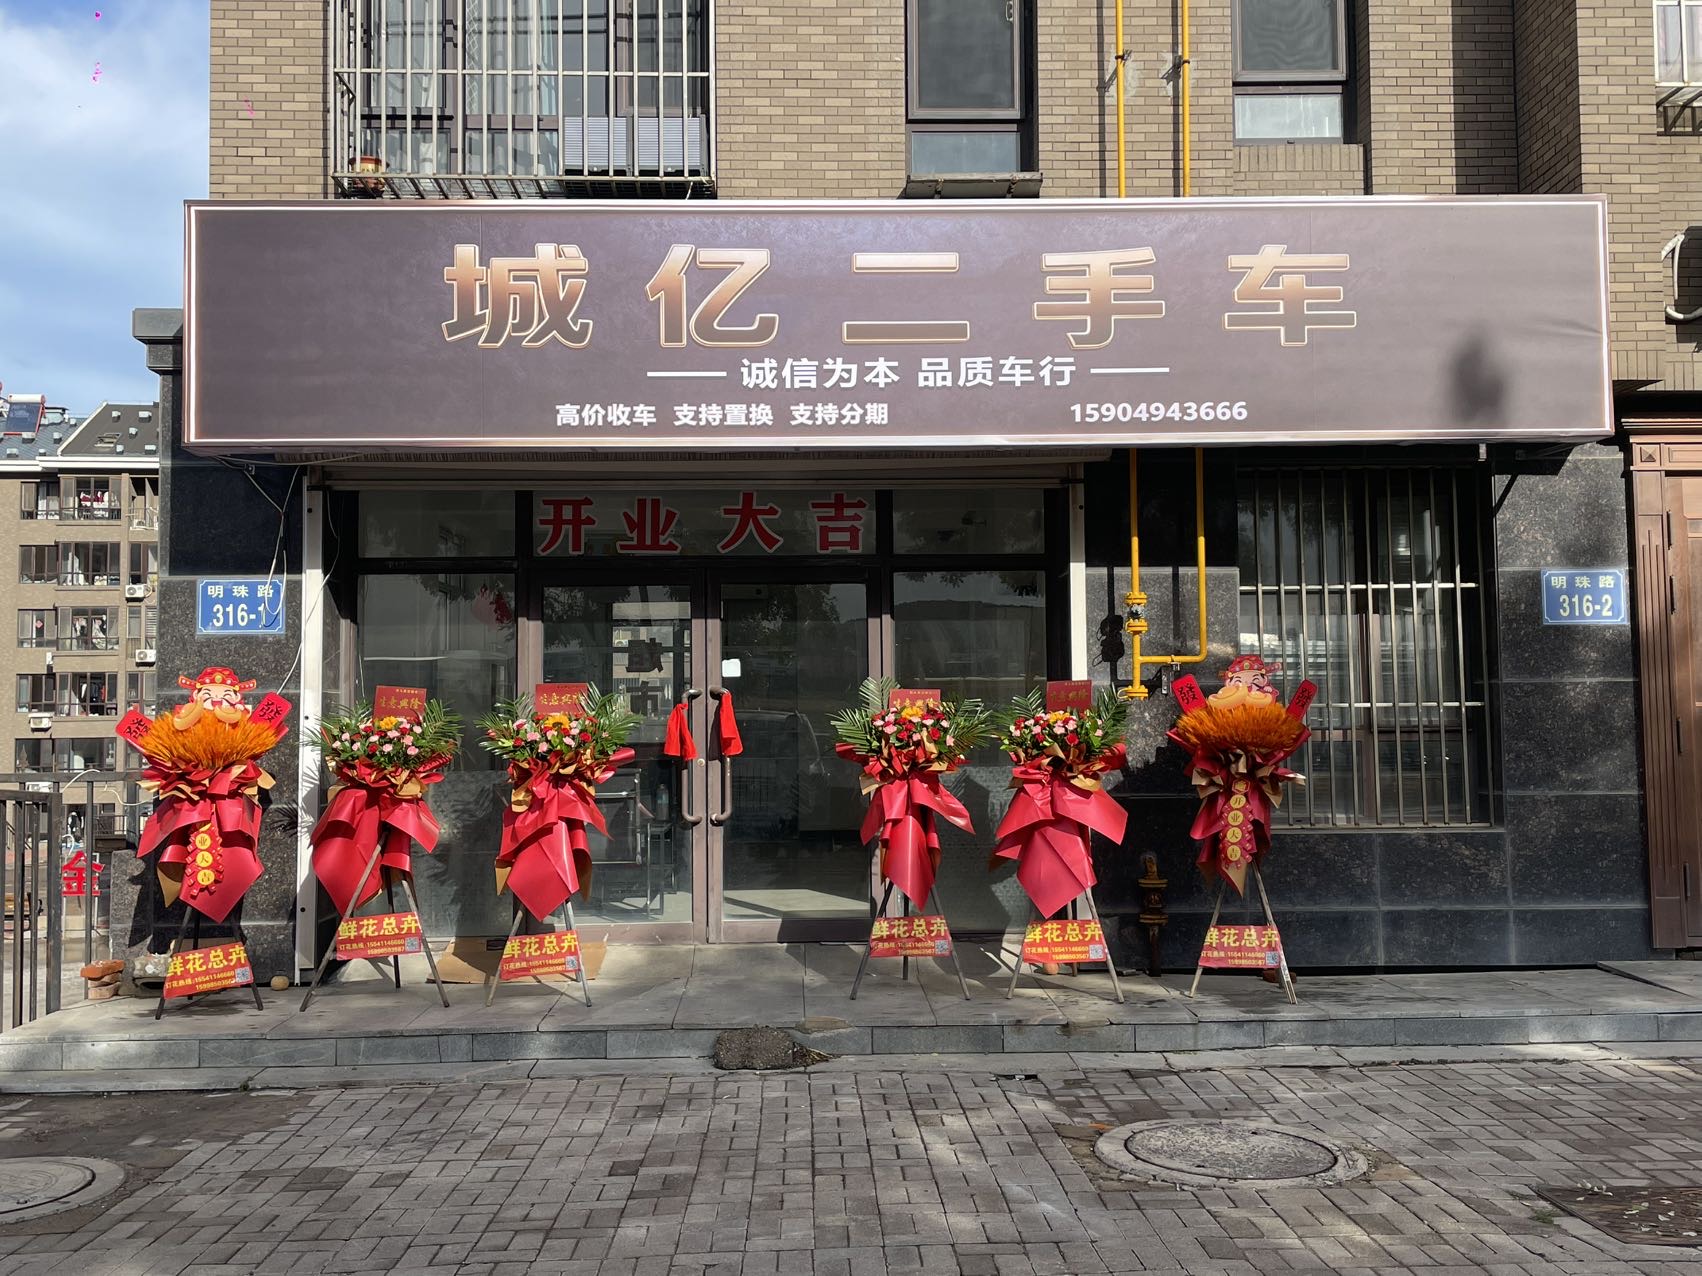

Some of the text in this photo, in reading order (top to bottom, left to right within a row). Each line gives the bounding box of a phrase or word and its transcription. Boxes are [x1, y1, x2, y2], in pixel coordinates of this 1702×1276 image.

[441, 243, 1357, 349] 城亿二手车
[741, 355, 1077, 389] 诚信为本 品质车行
[555, 402, 889, 427] 高价收车 支持置换 支持分期
[1070, 401, 1248, 423] 15904943666
[537, 491, 868, 554] 开业大吉
[207, 584, 274, 598] 明珠路
[1551, 575, 1615, 589] 明珠路
[212, 603, 266, 627] 316-1
[1559, 594, 1613, 617] 316-2
